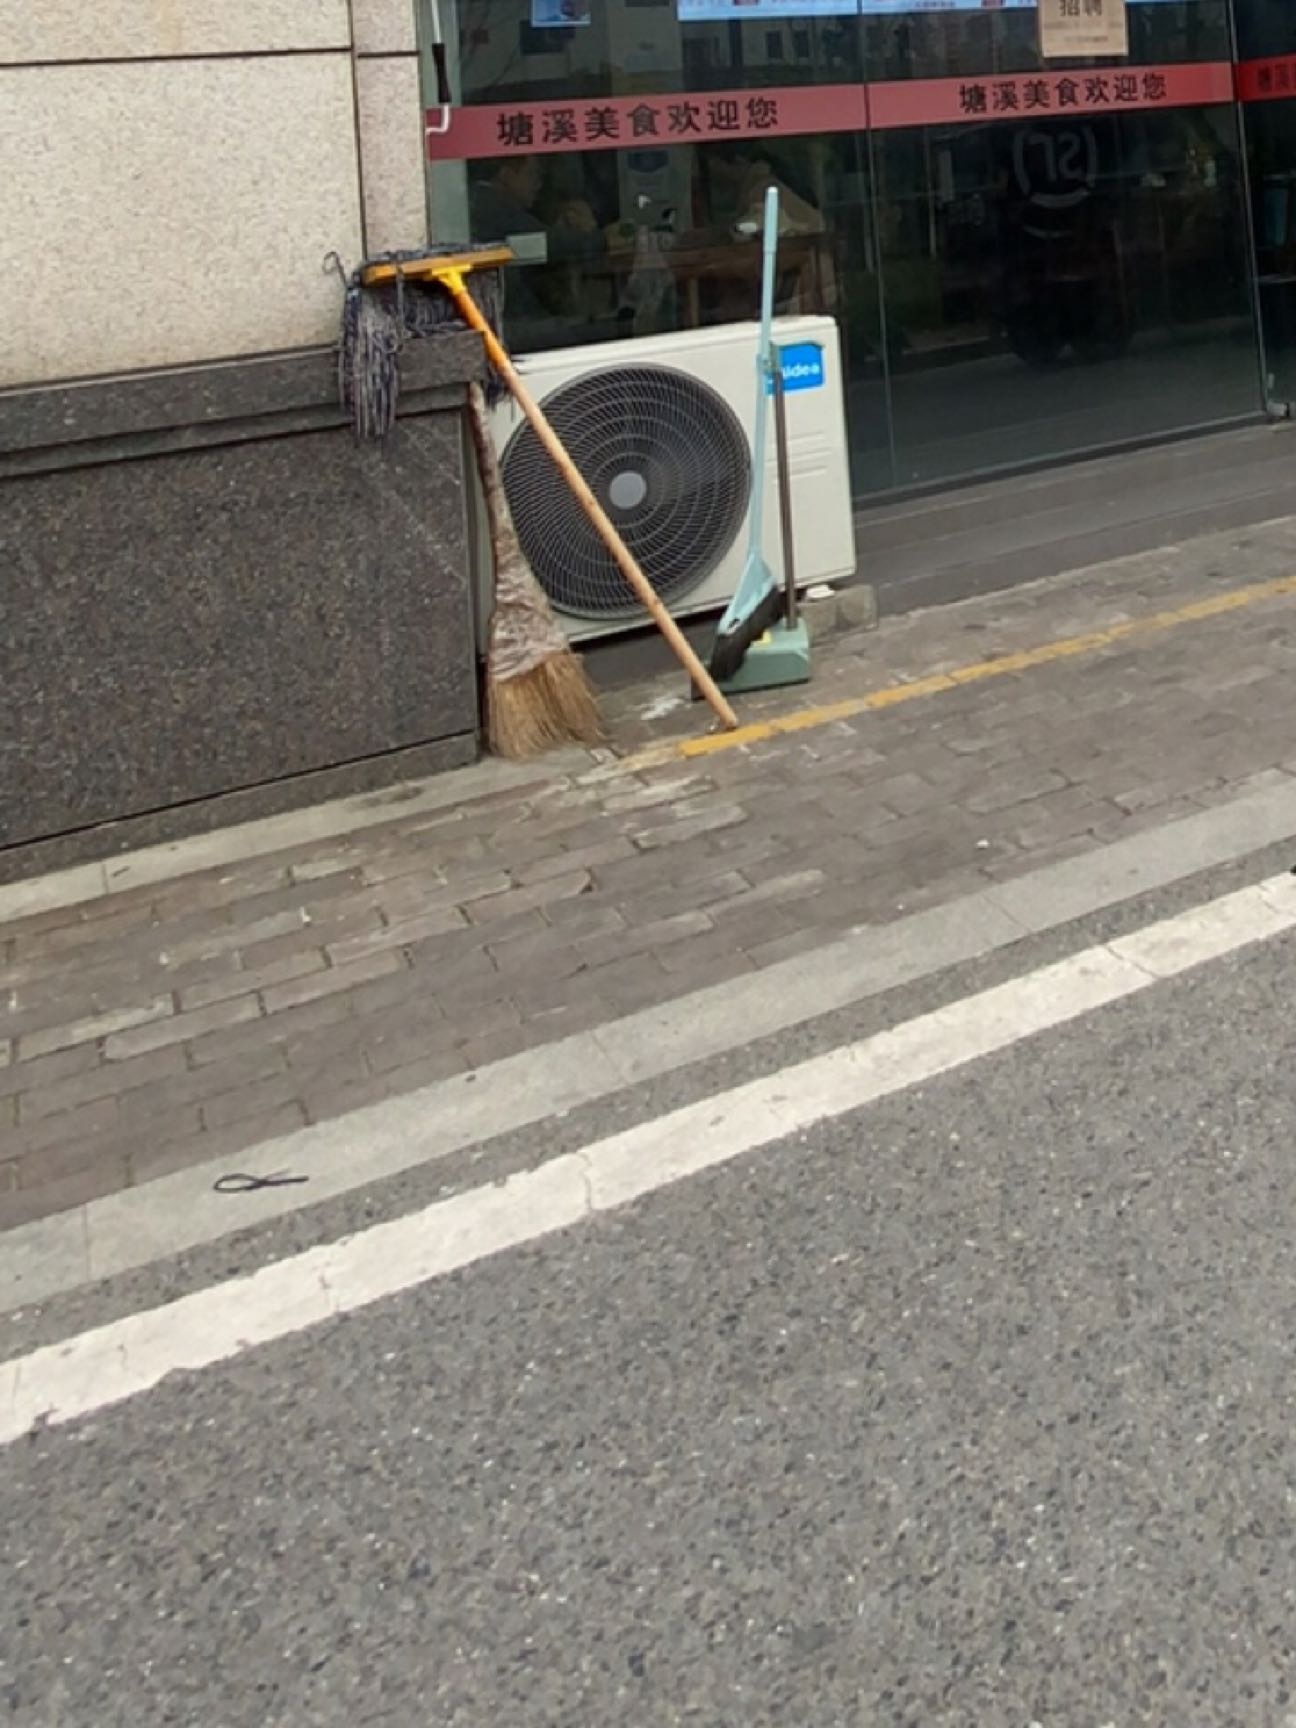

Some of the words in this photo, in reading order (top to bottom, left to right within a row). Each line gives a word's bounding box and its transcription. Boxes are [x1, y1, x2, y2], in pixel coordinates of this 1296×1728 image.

[958, 72, 1168, 114] 塘溪美食欢迎您
[496, 97, 779, 147] 塘溪美食欢迎您
